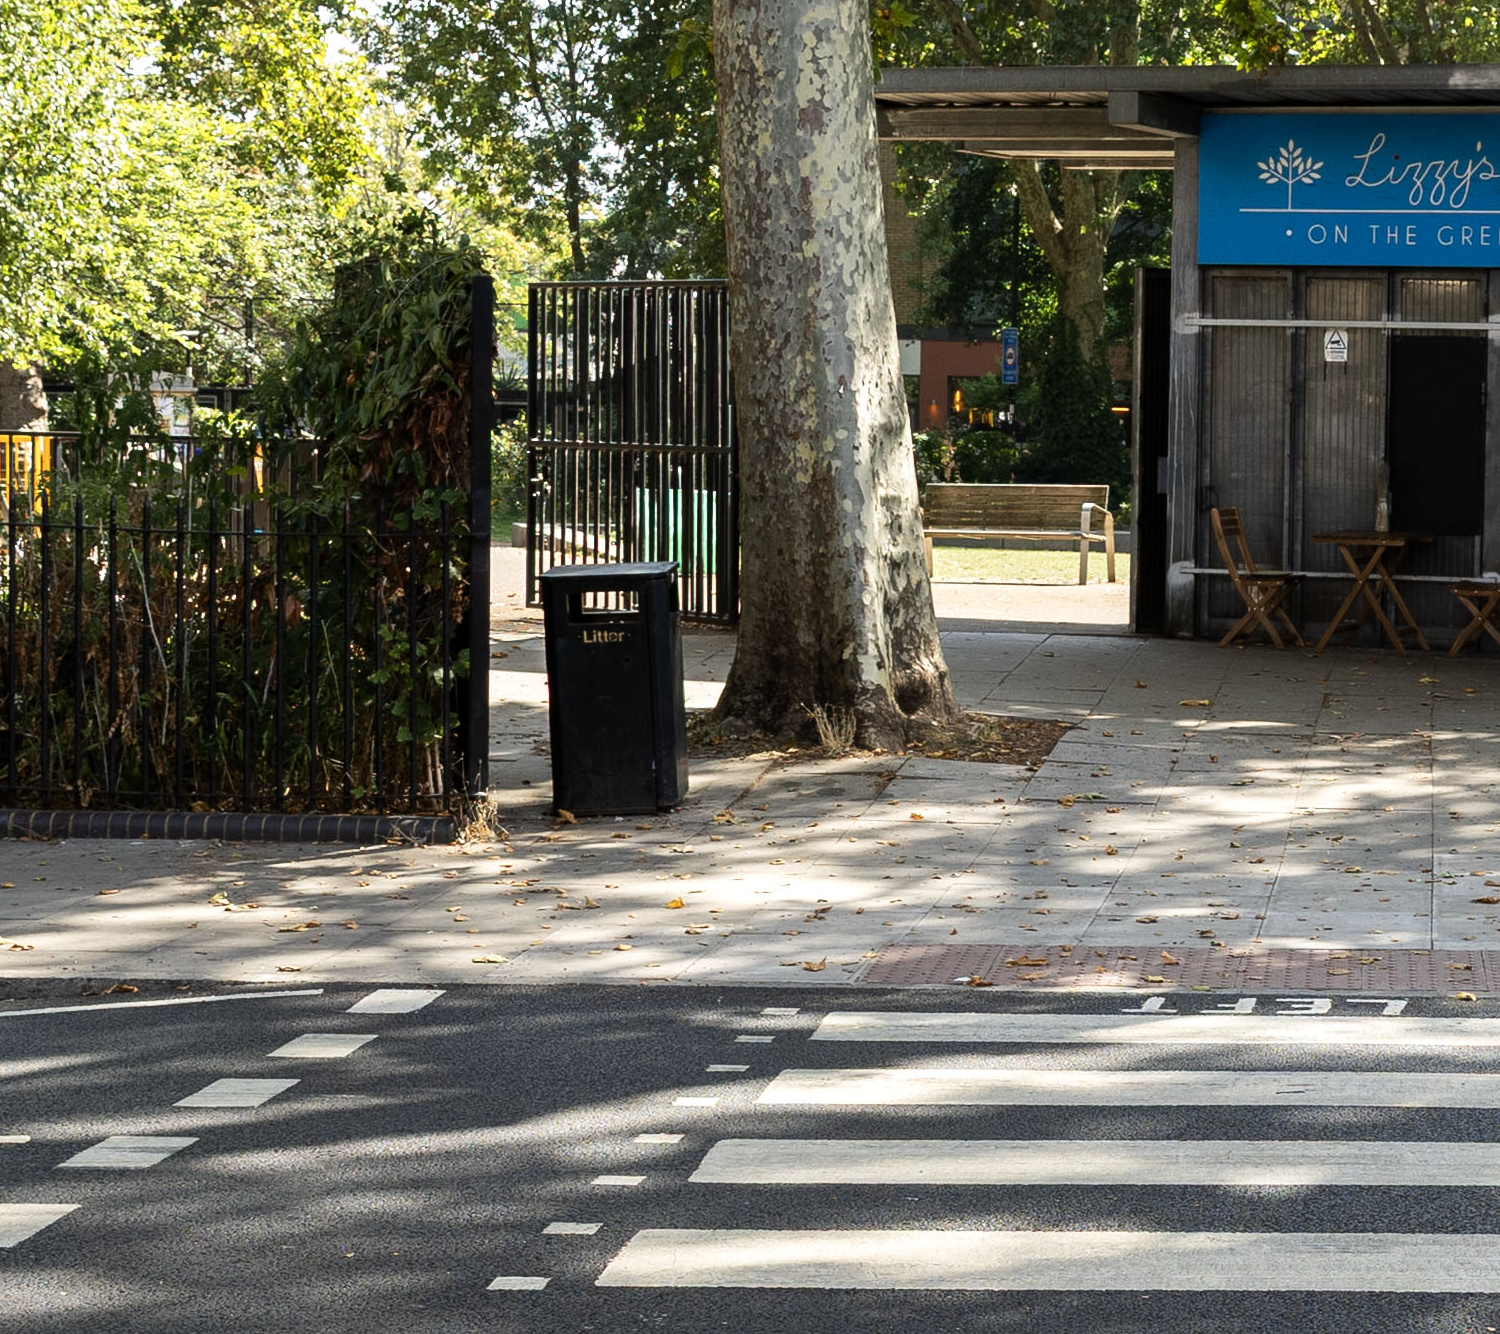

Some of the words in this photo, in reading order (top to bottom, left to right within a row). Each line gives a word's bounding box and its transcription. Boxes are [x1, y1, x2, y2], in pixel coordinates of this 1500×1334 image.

[1344, 132, 1500, 208] Lizzy's
[1307, 224, 1349, 244] ON
[1369, 224, 1418, 246] THE
[582, 629, 625, 644] Litter
[1121, 996, 1409, 1016] LEFT
